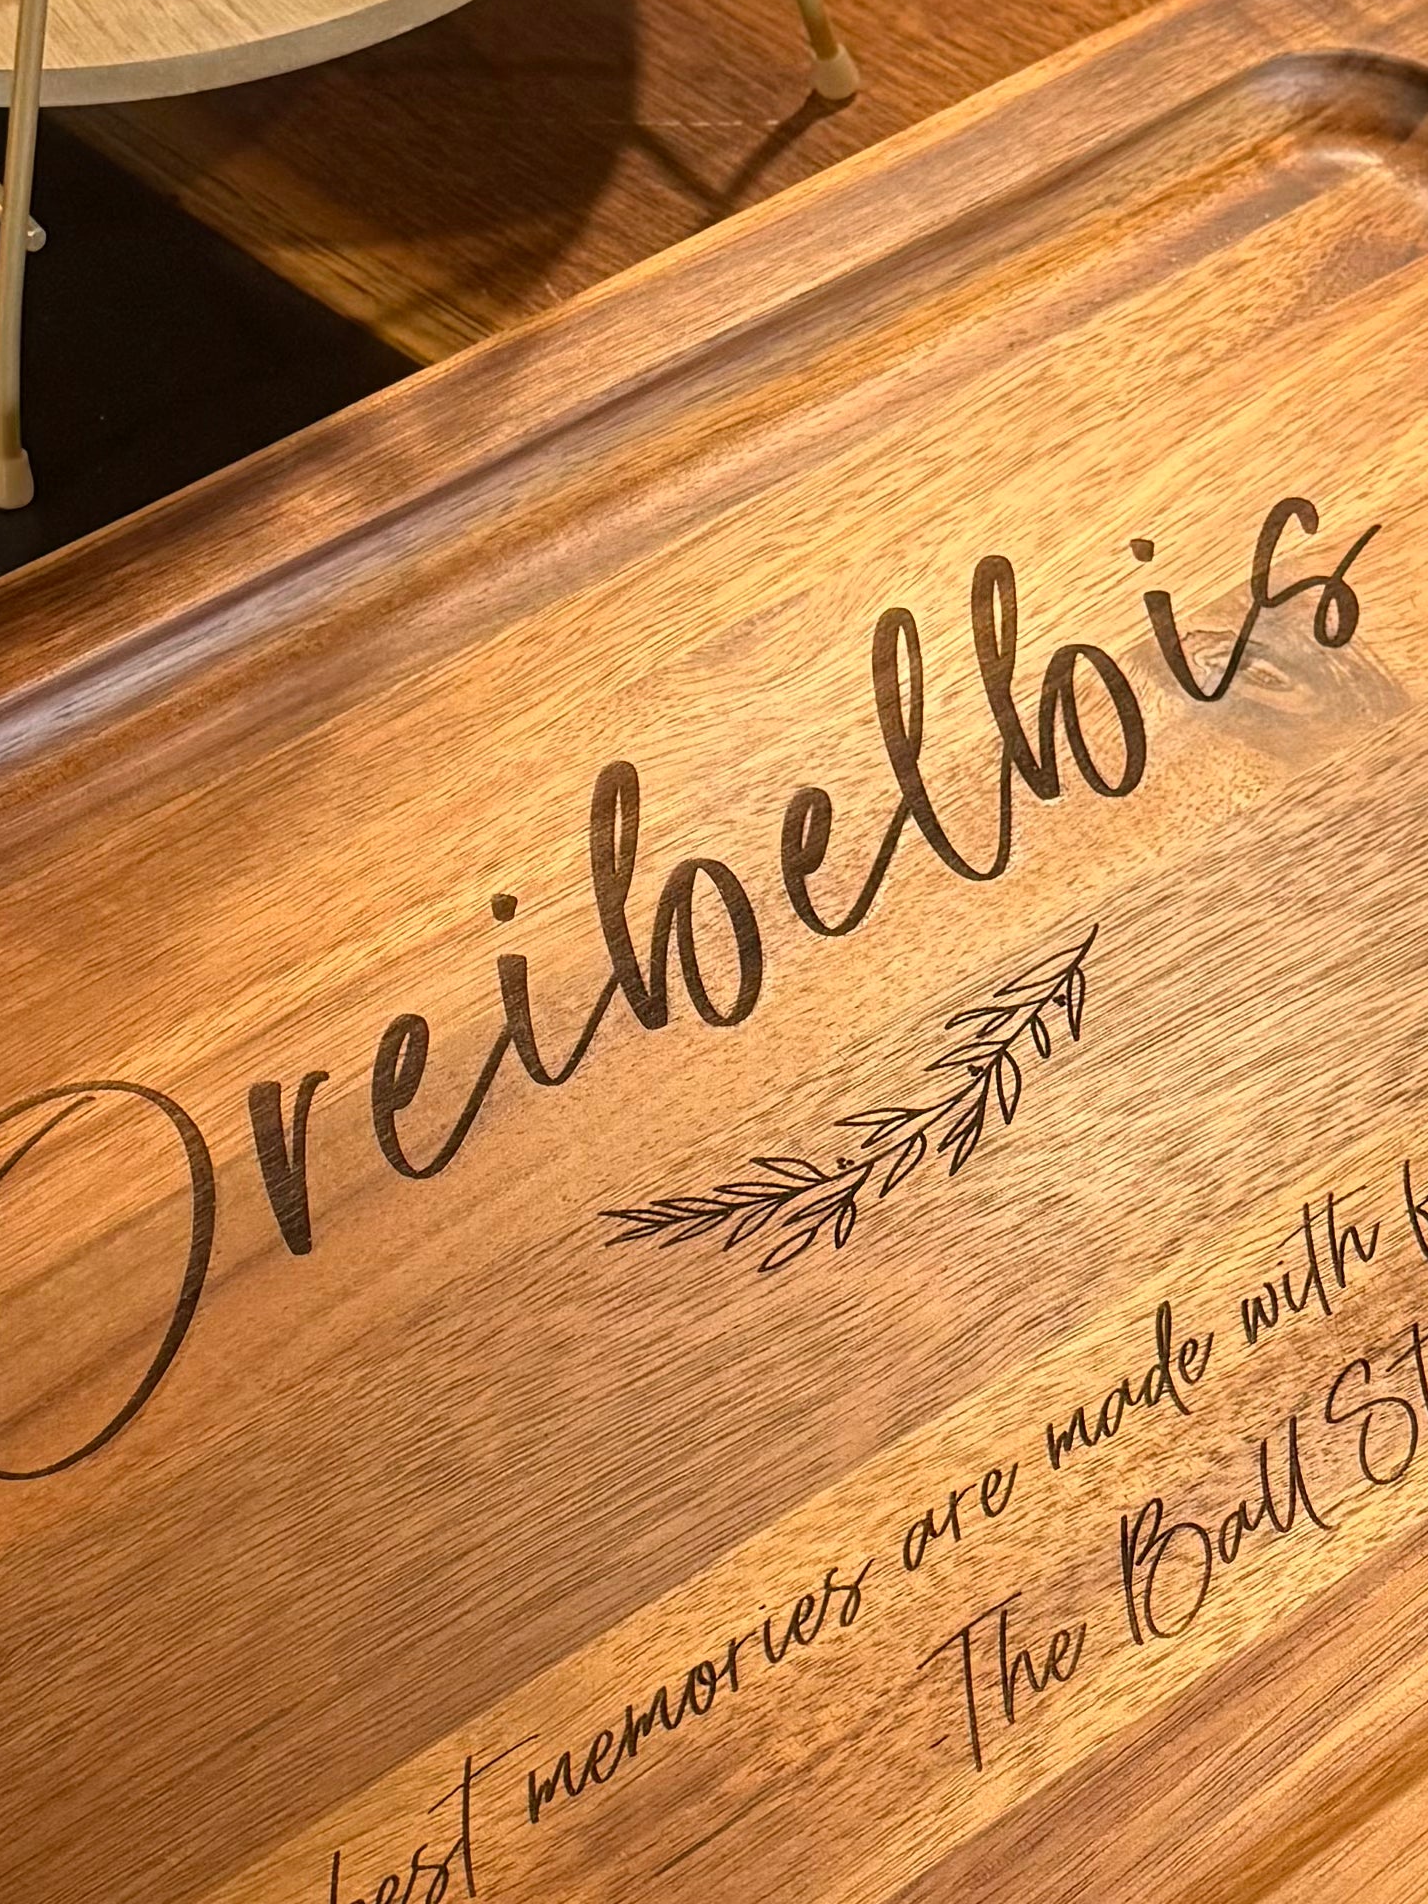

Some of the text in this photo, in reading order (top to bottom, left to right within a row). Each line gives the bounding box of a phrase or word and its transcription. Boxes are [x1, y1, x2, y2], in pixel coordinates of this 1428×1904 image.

[527, 1557, 876, 1825] memories
[903, 1462, 1018, 1570] are
[1045, 1301, 1213, 1470] made
[1239, 1191, 1381, 1343] with
[917, 1590, 1087, 1772] The
[1119, 1414, 1333, 1645] Ball
